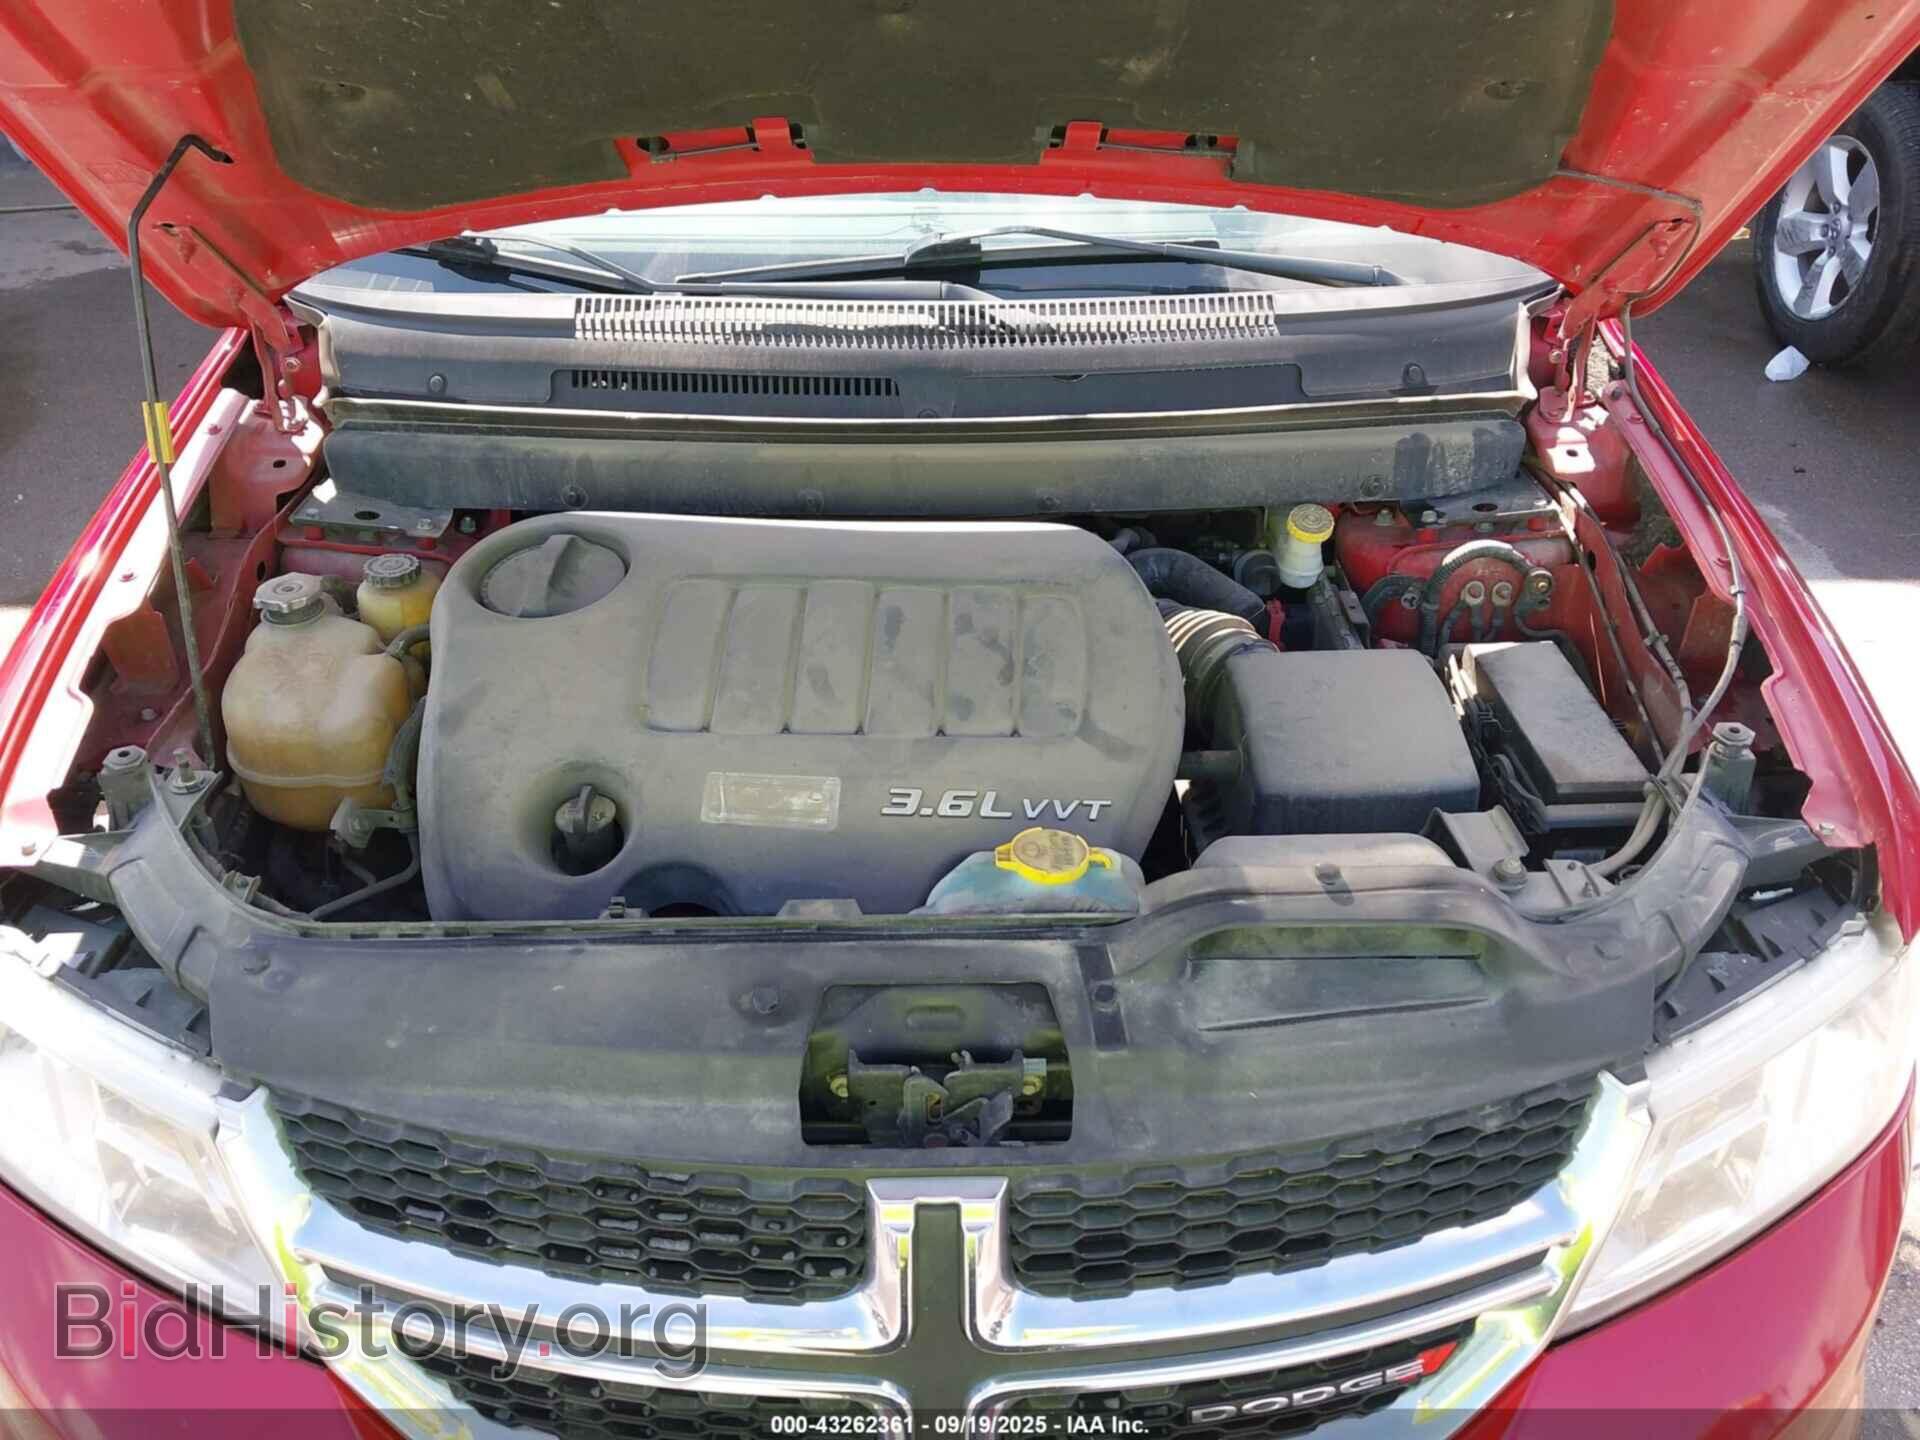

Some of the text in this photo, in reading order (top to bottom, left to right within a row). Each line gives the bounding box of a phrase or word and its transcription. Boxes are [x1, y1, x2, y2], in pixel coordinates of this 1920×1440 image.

[880, 787, 1112, 820] 3.6L VVT
[1191, 1360, 1424, 1423] DODGE
